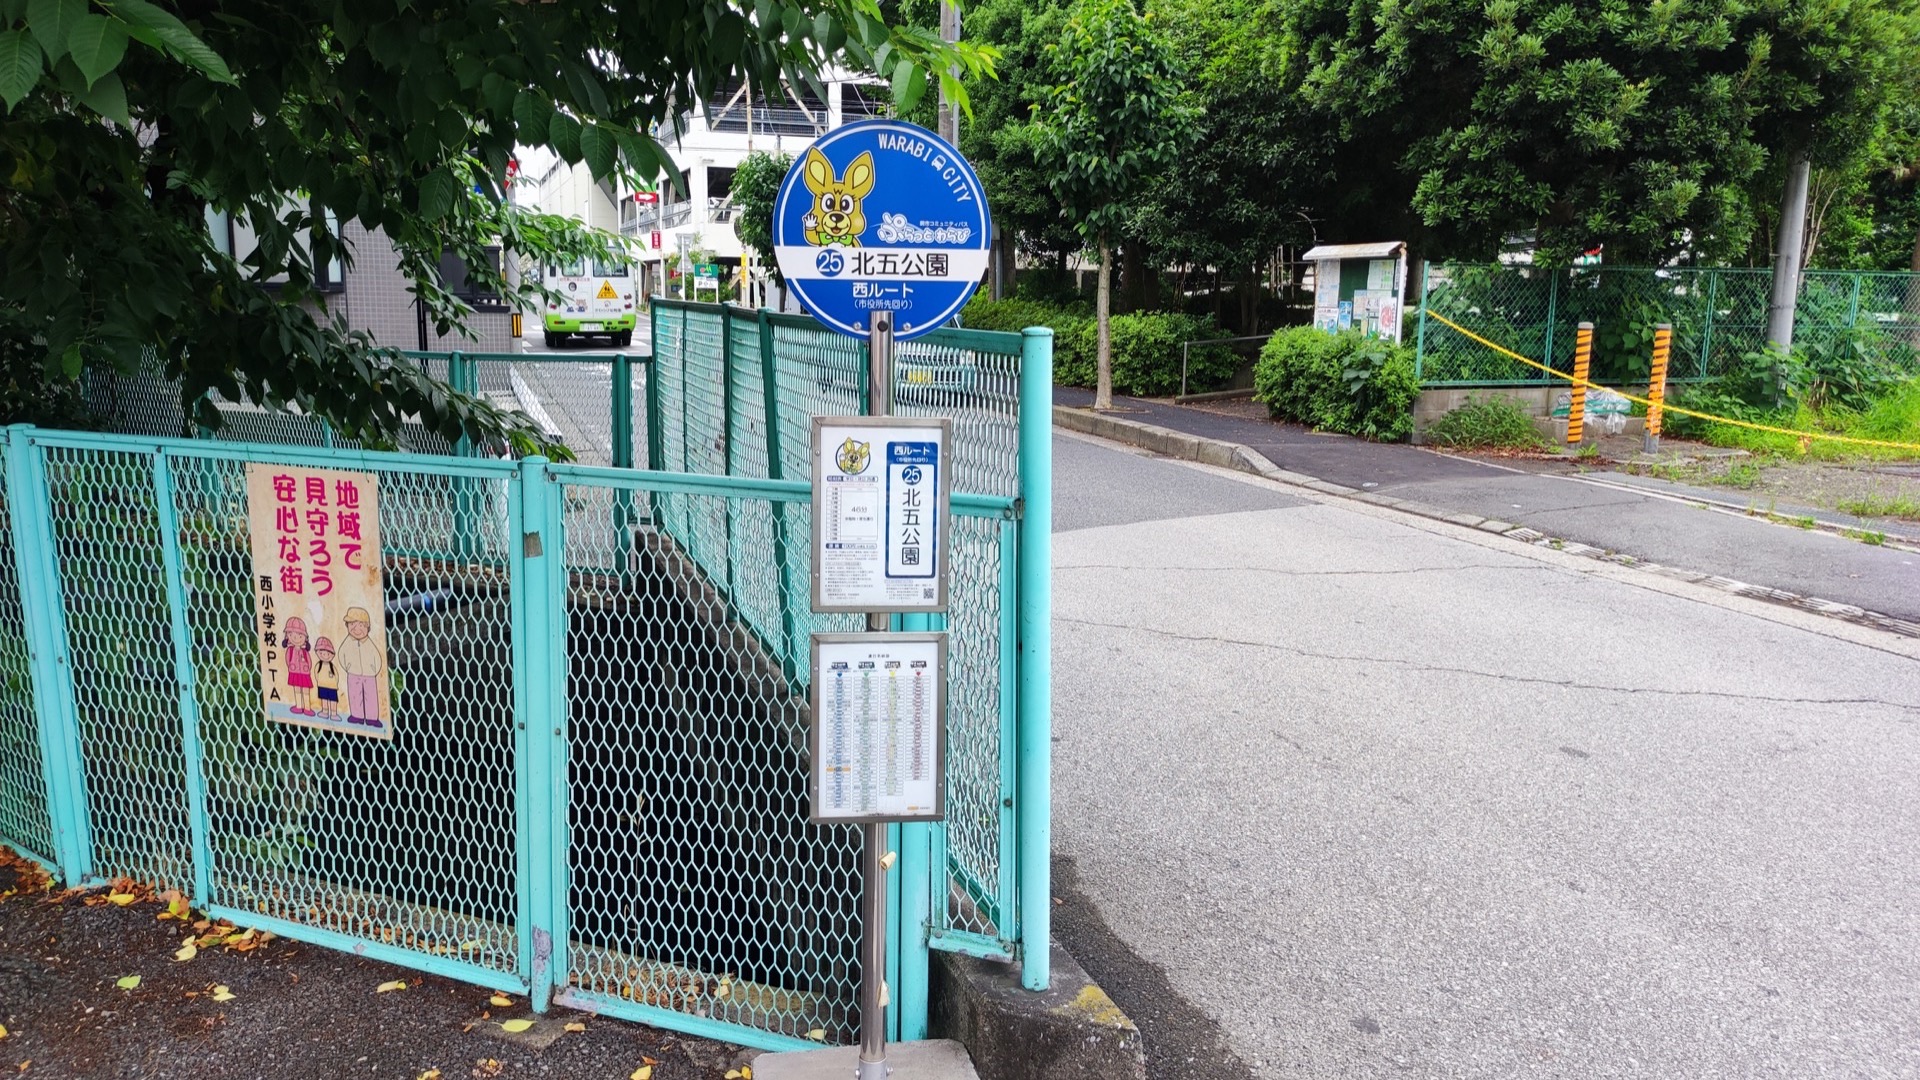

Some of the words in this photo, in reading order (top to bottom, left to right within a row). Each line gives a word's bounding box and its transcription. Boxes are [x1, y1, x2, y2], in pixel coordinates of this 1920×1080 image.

[878, 133, 933, 162] WARABI
[942, 166, 972, 202] CITY
[818, 252, 843, 272] 25
[851, 252, 948, 277] 北五公園
[853, 283, 914, 298] 西ルート
[894, 445, 930, 456] 西ルート
[904, 468, 920, 483] 25
[273, 474, 303, 594] 安心な街
[305, 477, 333, 596] 見守ろう
[335, 479, 362, 571] 地域で
[902, 488, 921, 565] 北五公園
[259, 575, 281, 701] 西小学校PTA
